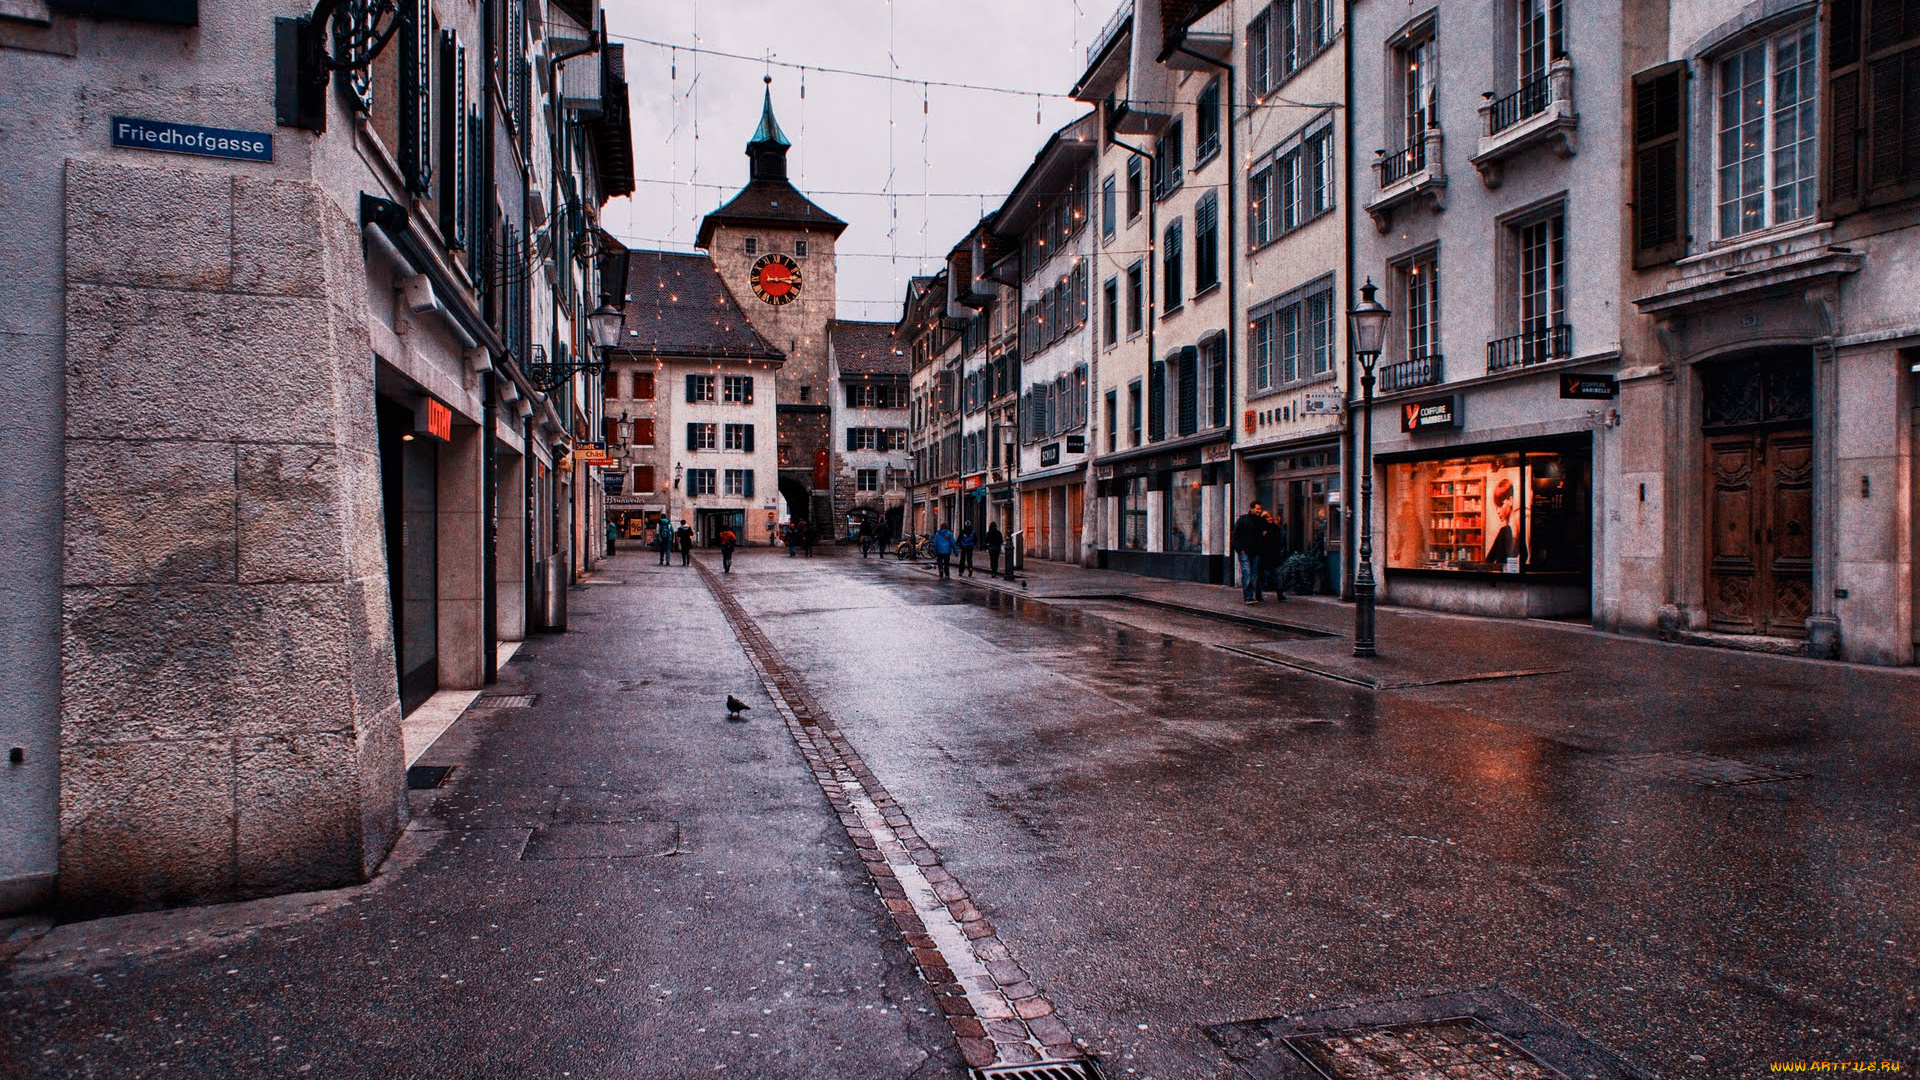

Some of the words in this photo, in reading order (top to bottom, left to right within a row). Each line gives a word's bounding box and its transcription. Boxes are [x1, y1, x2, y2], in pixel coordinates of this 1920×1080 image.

[118, 123, 265, 154] Friedhofgasse
[1420, 405, 1447, 417] COIFFURE
[1420, 413, 1452, 425] VARIBELLE
[1042, 448, 1056, 462] SCHILD
